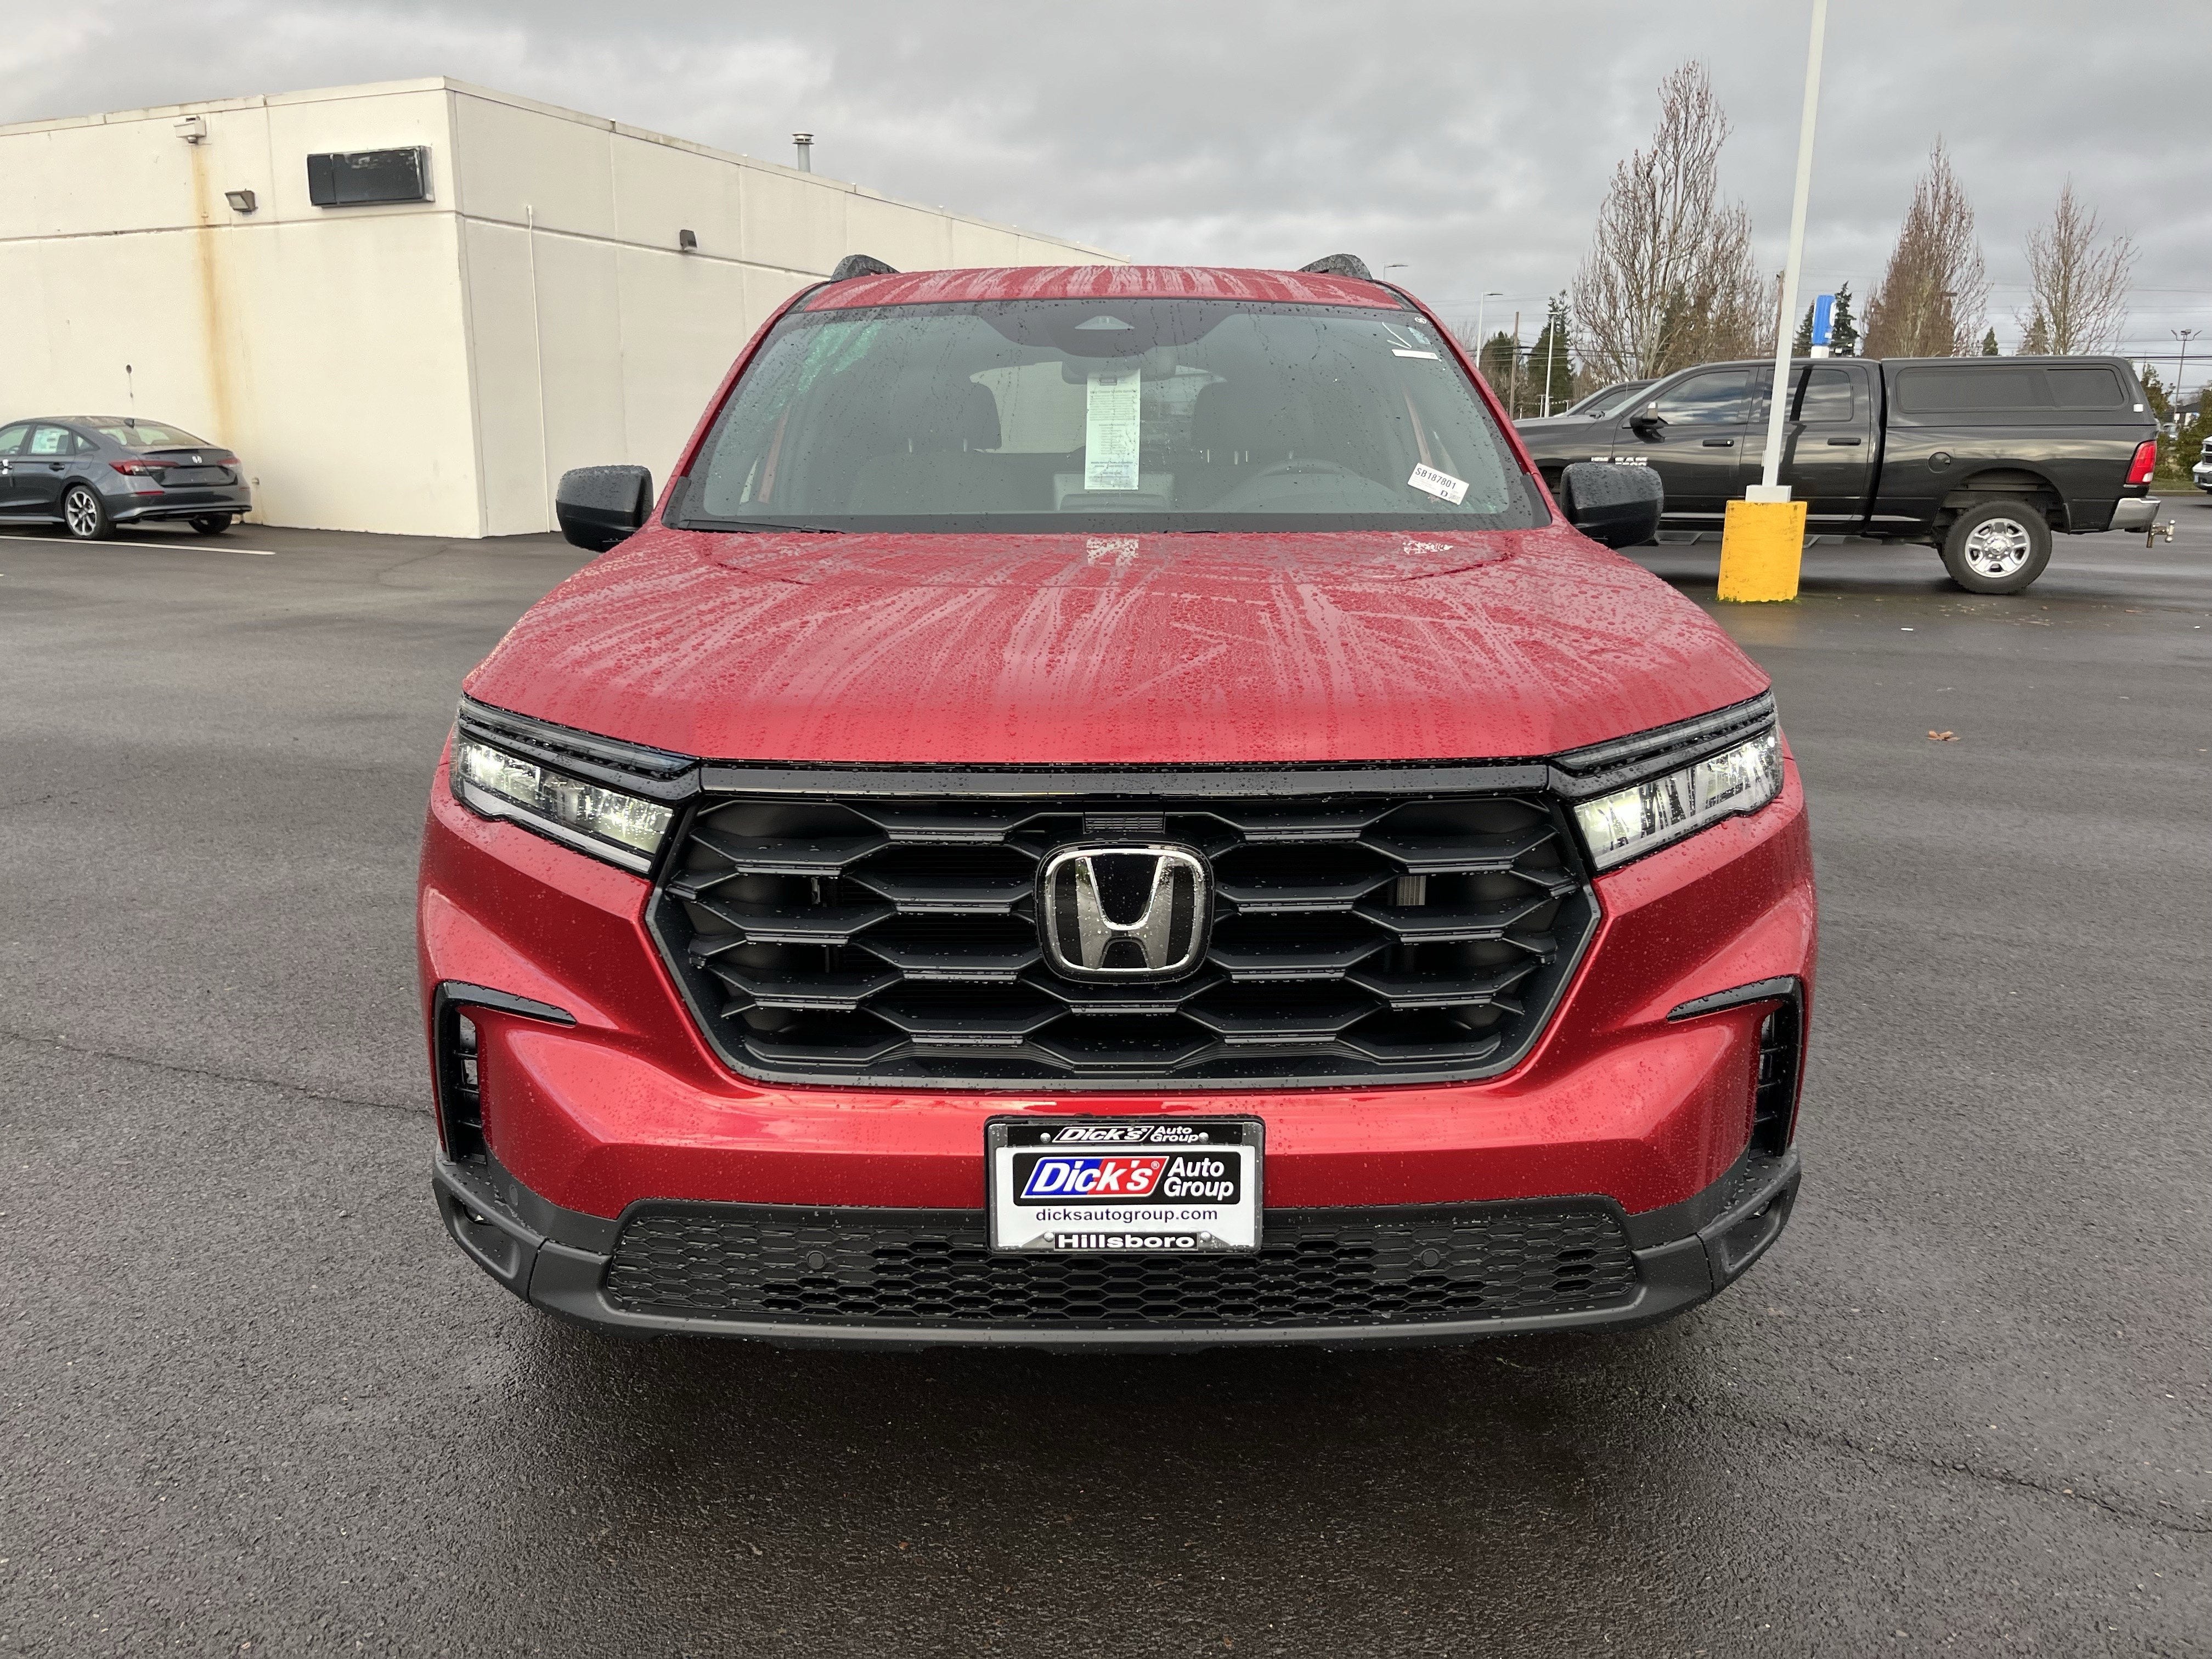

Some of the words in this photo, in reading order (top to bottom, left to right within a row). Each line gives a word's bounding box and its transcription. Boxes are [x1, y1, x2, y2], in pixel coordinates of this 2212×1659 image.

[1415, 467, 1457, 489] SB187801
[1153, 1126, 1192, 1134] Auto
[1150, 1133, 1199, 1143] Group
[1167, 1156, 1224, 1177] Auto
[1164, 1176, 1234, 1201] Group
[1036, 1208, 1218, 1223] dicksautogroup.com
[1058, 1234, 1195, 1248] Hillsboro
